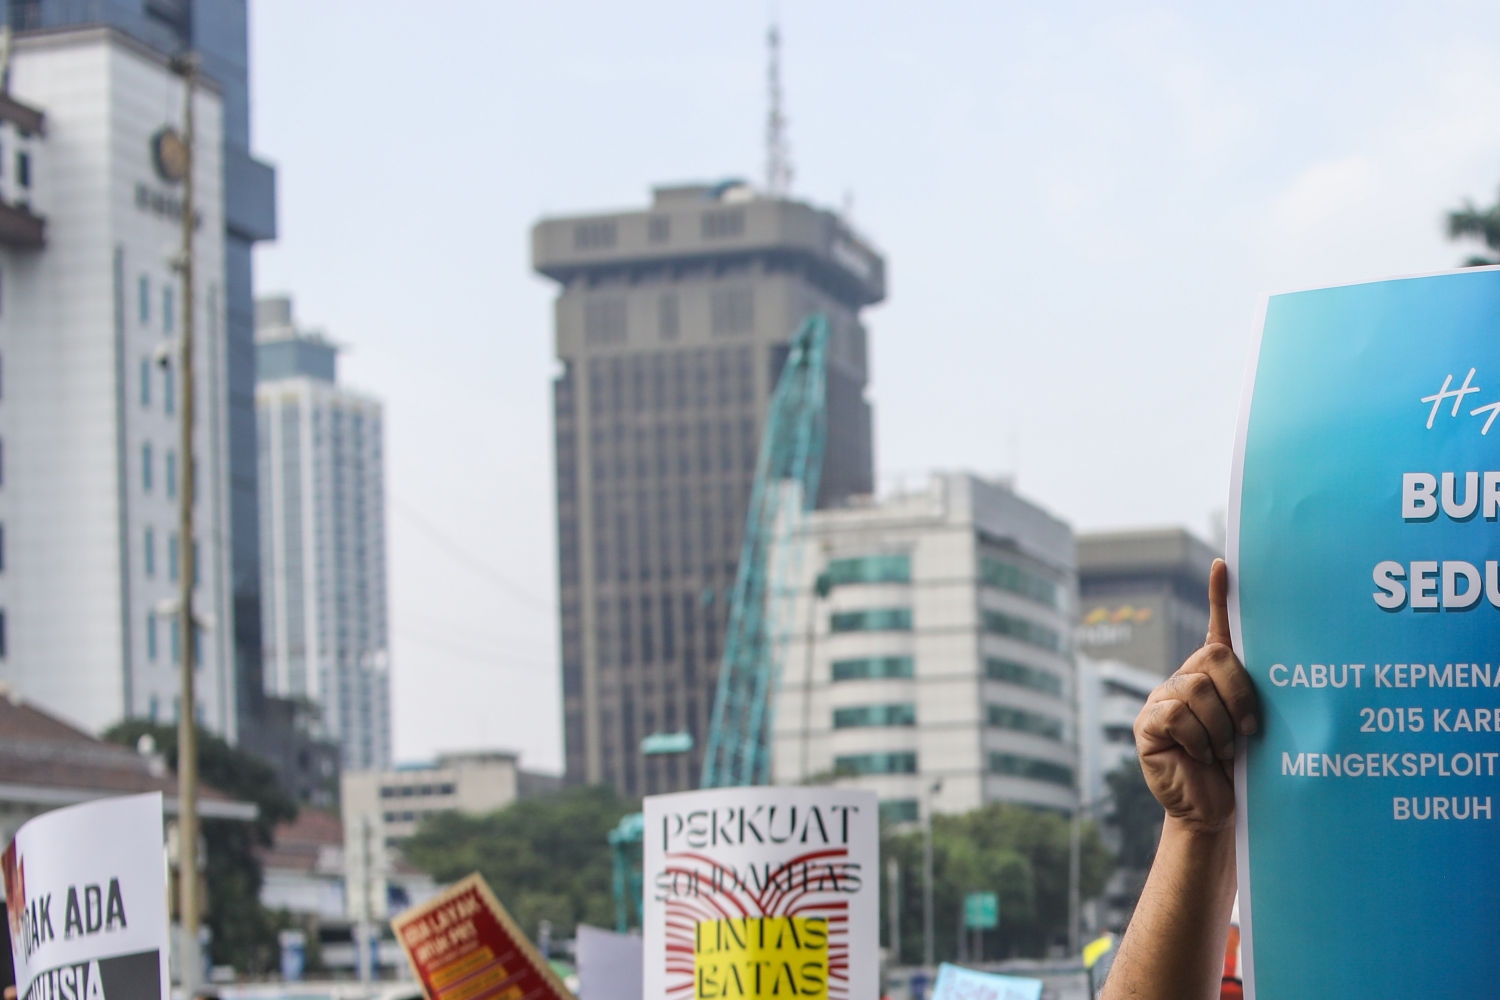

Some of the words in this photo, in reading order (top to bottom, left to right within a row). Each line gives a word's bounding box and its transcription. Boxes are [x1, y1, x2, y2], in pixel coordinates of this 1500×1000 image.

[1268, 663, 1366, 689] CABUT
[1359, 708, 1424, 733] 2015
[1392, 797, 1493, 820] BURUH
[663, 804, 859, 853] PERKUAT
[65, 877, 127, 940] ADA
[696, 915, 829, 955] LINTAS
[698, 961, 825, 1000] BATAS
